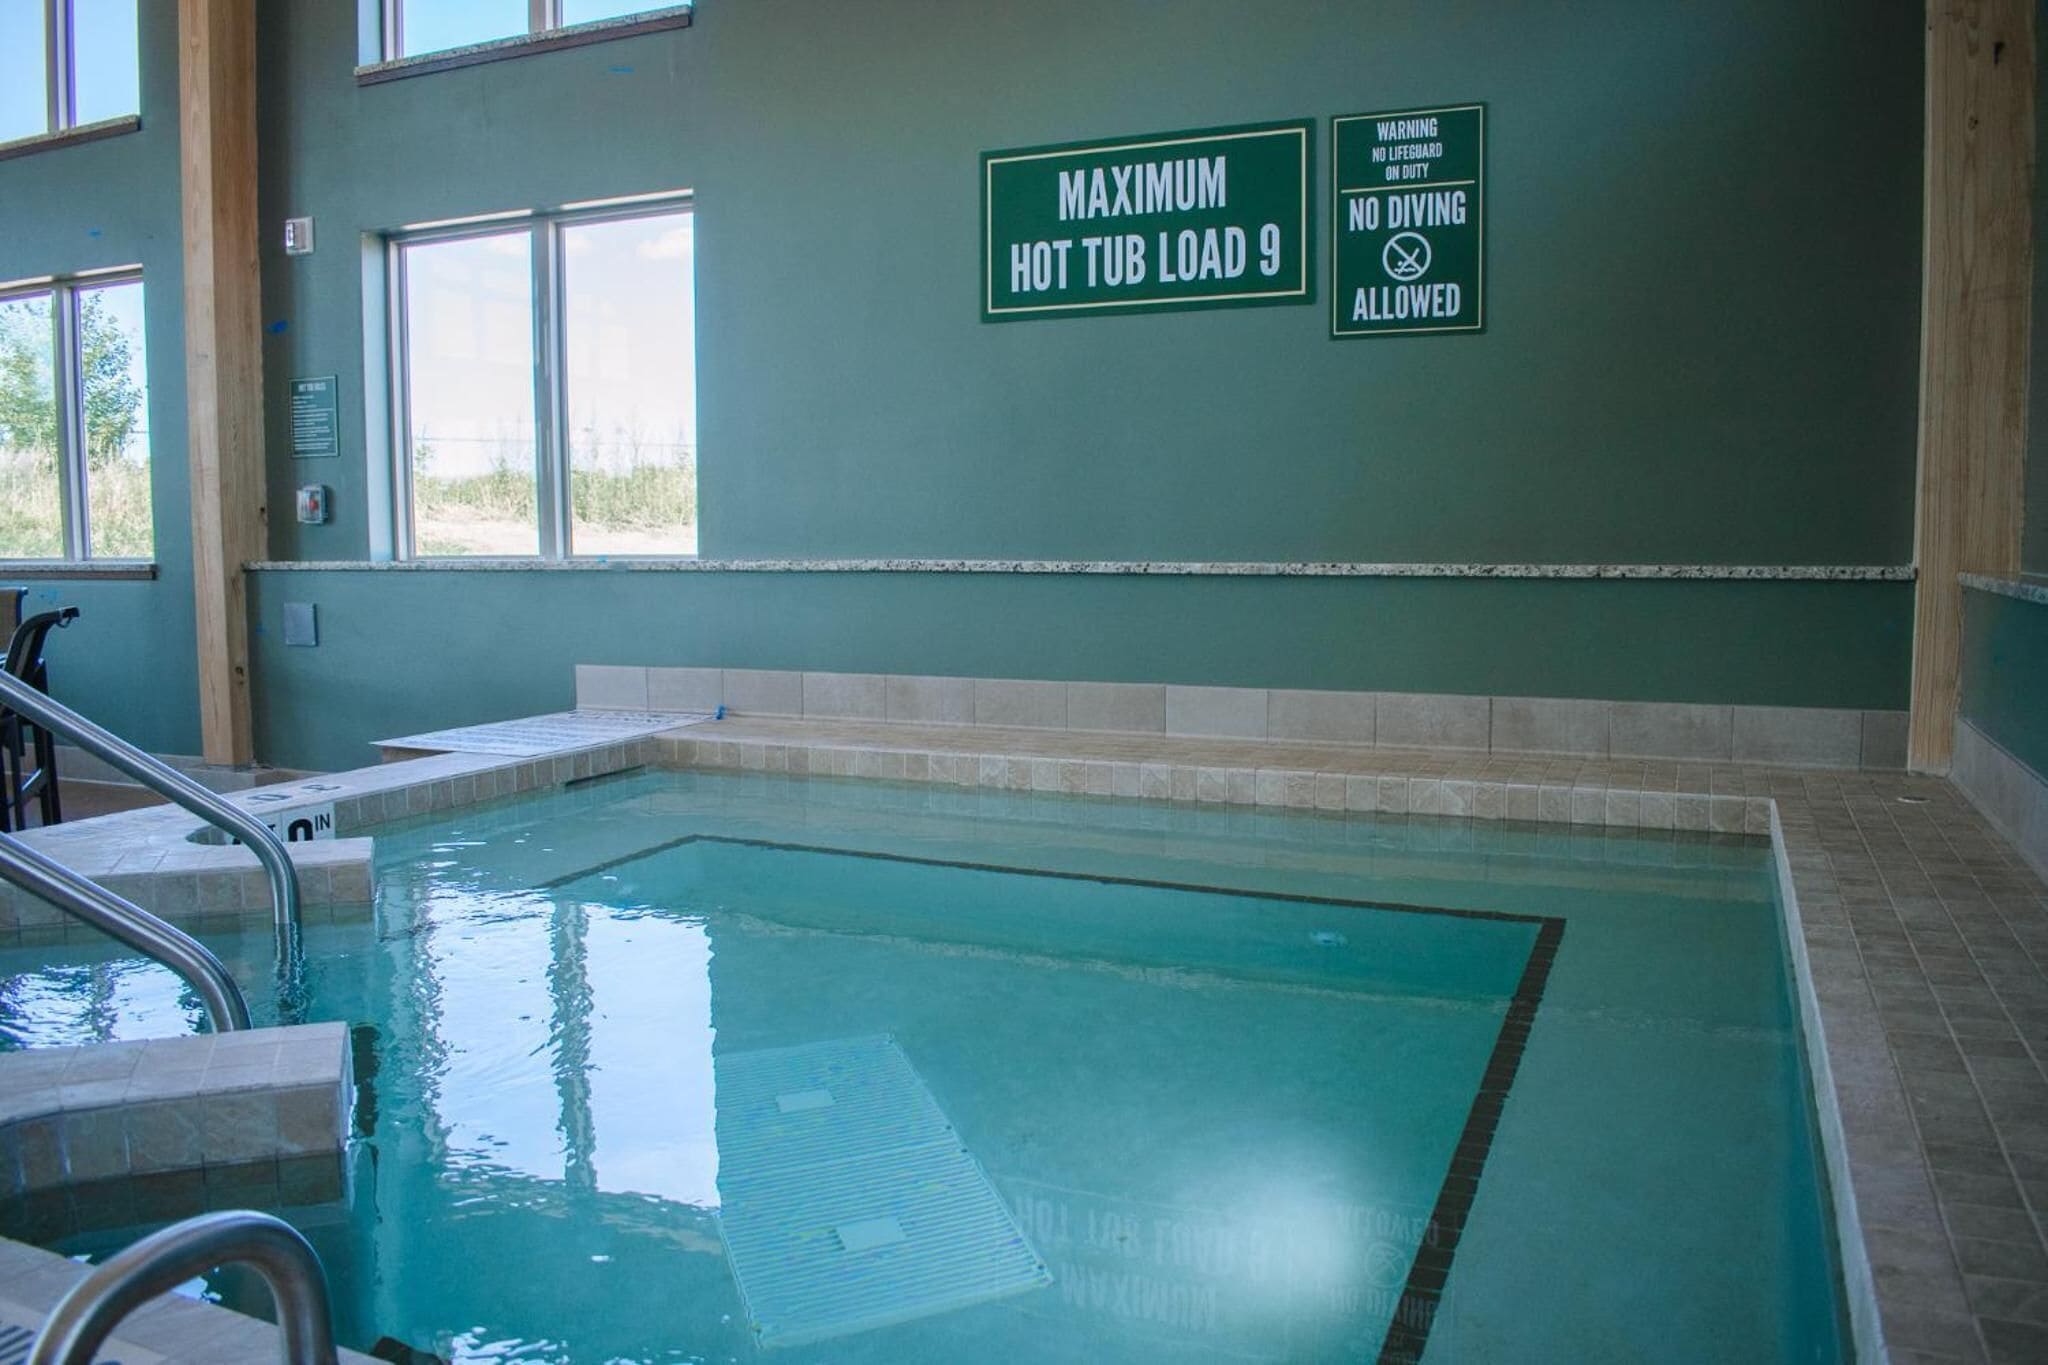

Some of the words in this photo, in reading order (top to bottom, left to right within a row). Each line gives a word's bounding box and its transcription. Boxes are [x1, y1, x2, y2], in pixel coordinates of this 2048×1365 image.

[1376, 117, 1438, 141] WARNING
[1372, 146, 1386, 163] NO
[1388, 142, 1443, 161] LIFEGUARD
[1385, 164, 1400, 181] ON
[1402, 162, 1429, 179] DUTY
[1058, 155, 1226, 221] MAXIMUM
[1349, 196, 1379, 231] NO
[1388, 190, 1466, 229] DIVING
[1011, 239, 1073, 293] HOT
[1082, 234, 1146, 287] TUB
[1159, 226, 1246, 282] LOAD
[1259, 222, 1280, 276] 9
[1352, 282, 1461, 321] ALLOWED
[314, 813, 331, 832] IN
